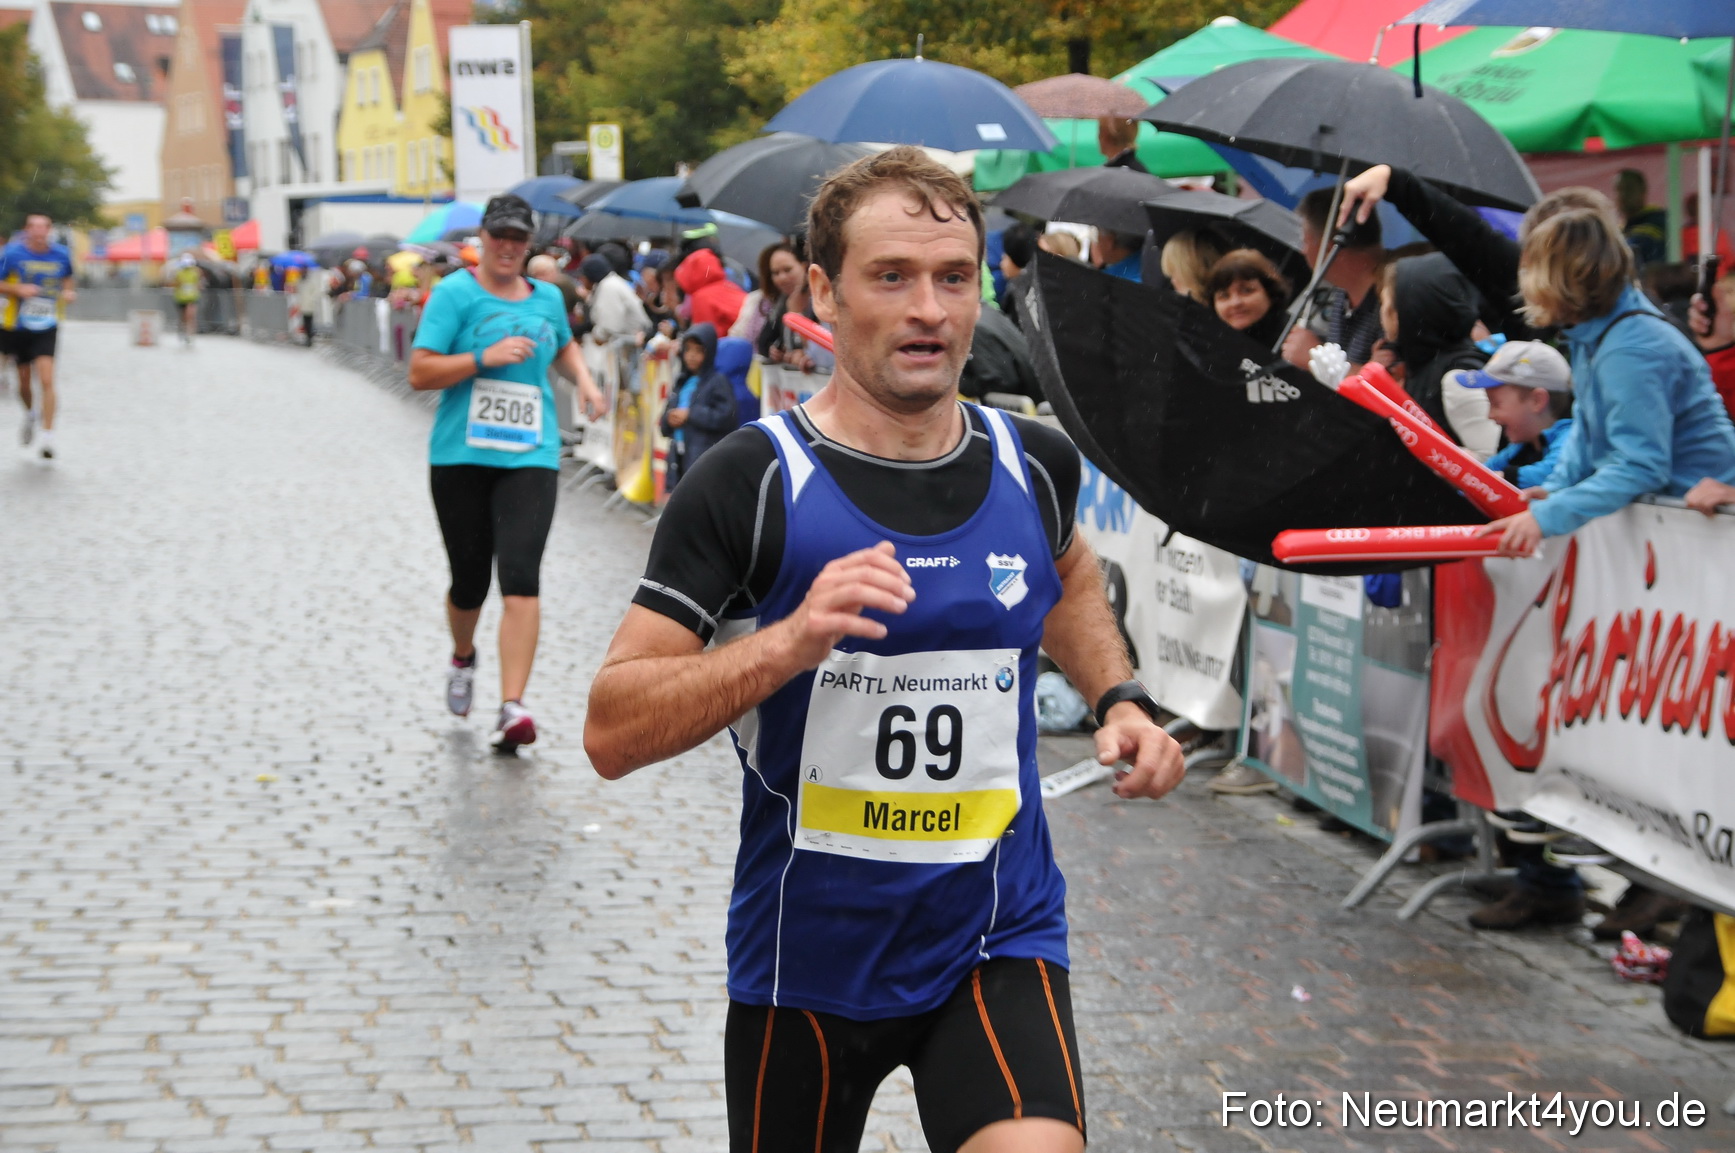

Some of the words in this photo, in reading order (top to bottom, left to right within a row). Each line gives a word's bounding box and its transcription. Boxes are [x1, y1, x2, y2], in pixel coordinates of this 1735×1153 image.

[477, 395, 535, 426] 2508
[1427, 448, 1463, 478] BKK
[1461, 472, 1503, 502] Audi
[1385, 526, 1426, 540] BKK
[1429, 525, 1476, 539] Audi
[906, 556, 950, 568] CRAFT
[819, 670, 888, 695] PARTL
[892, 672, 988, 693] Neumarkt
[875, 704, 963, 781] 69
[863, 800, 961, 833] Marcel
